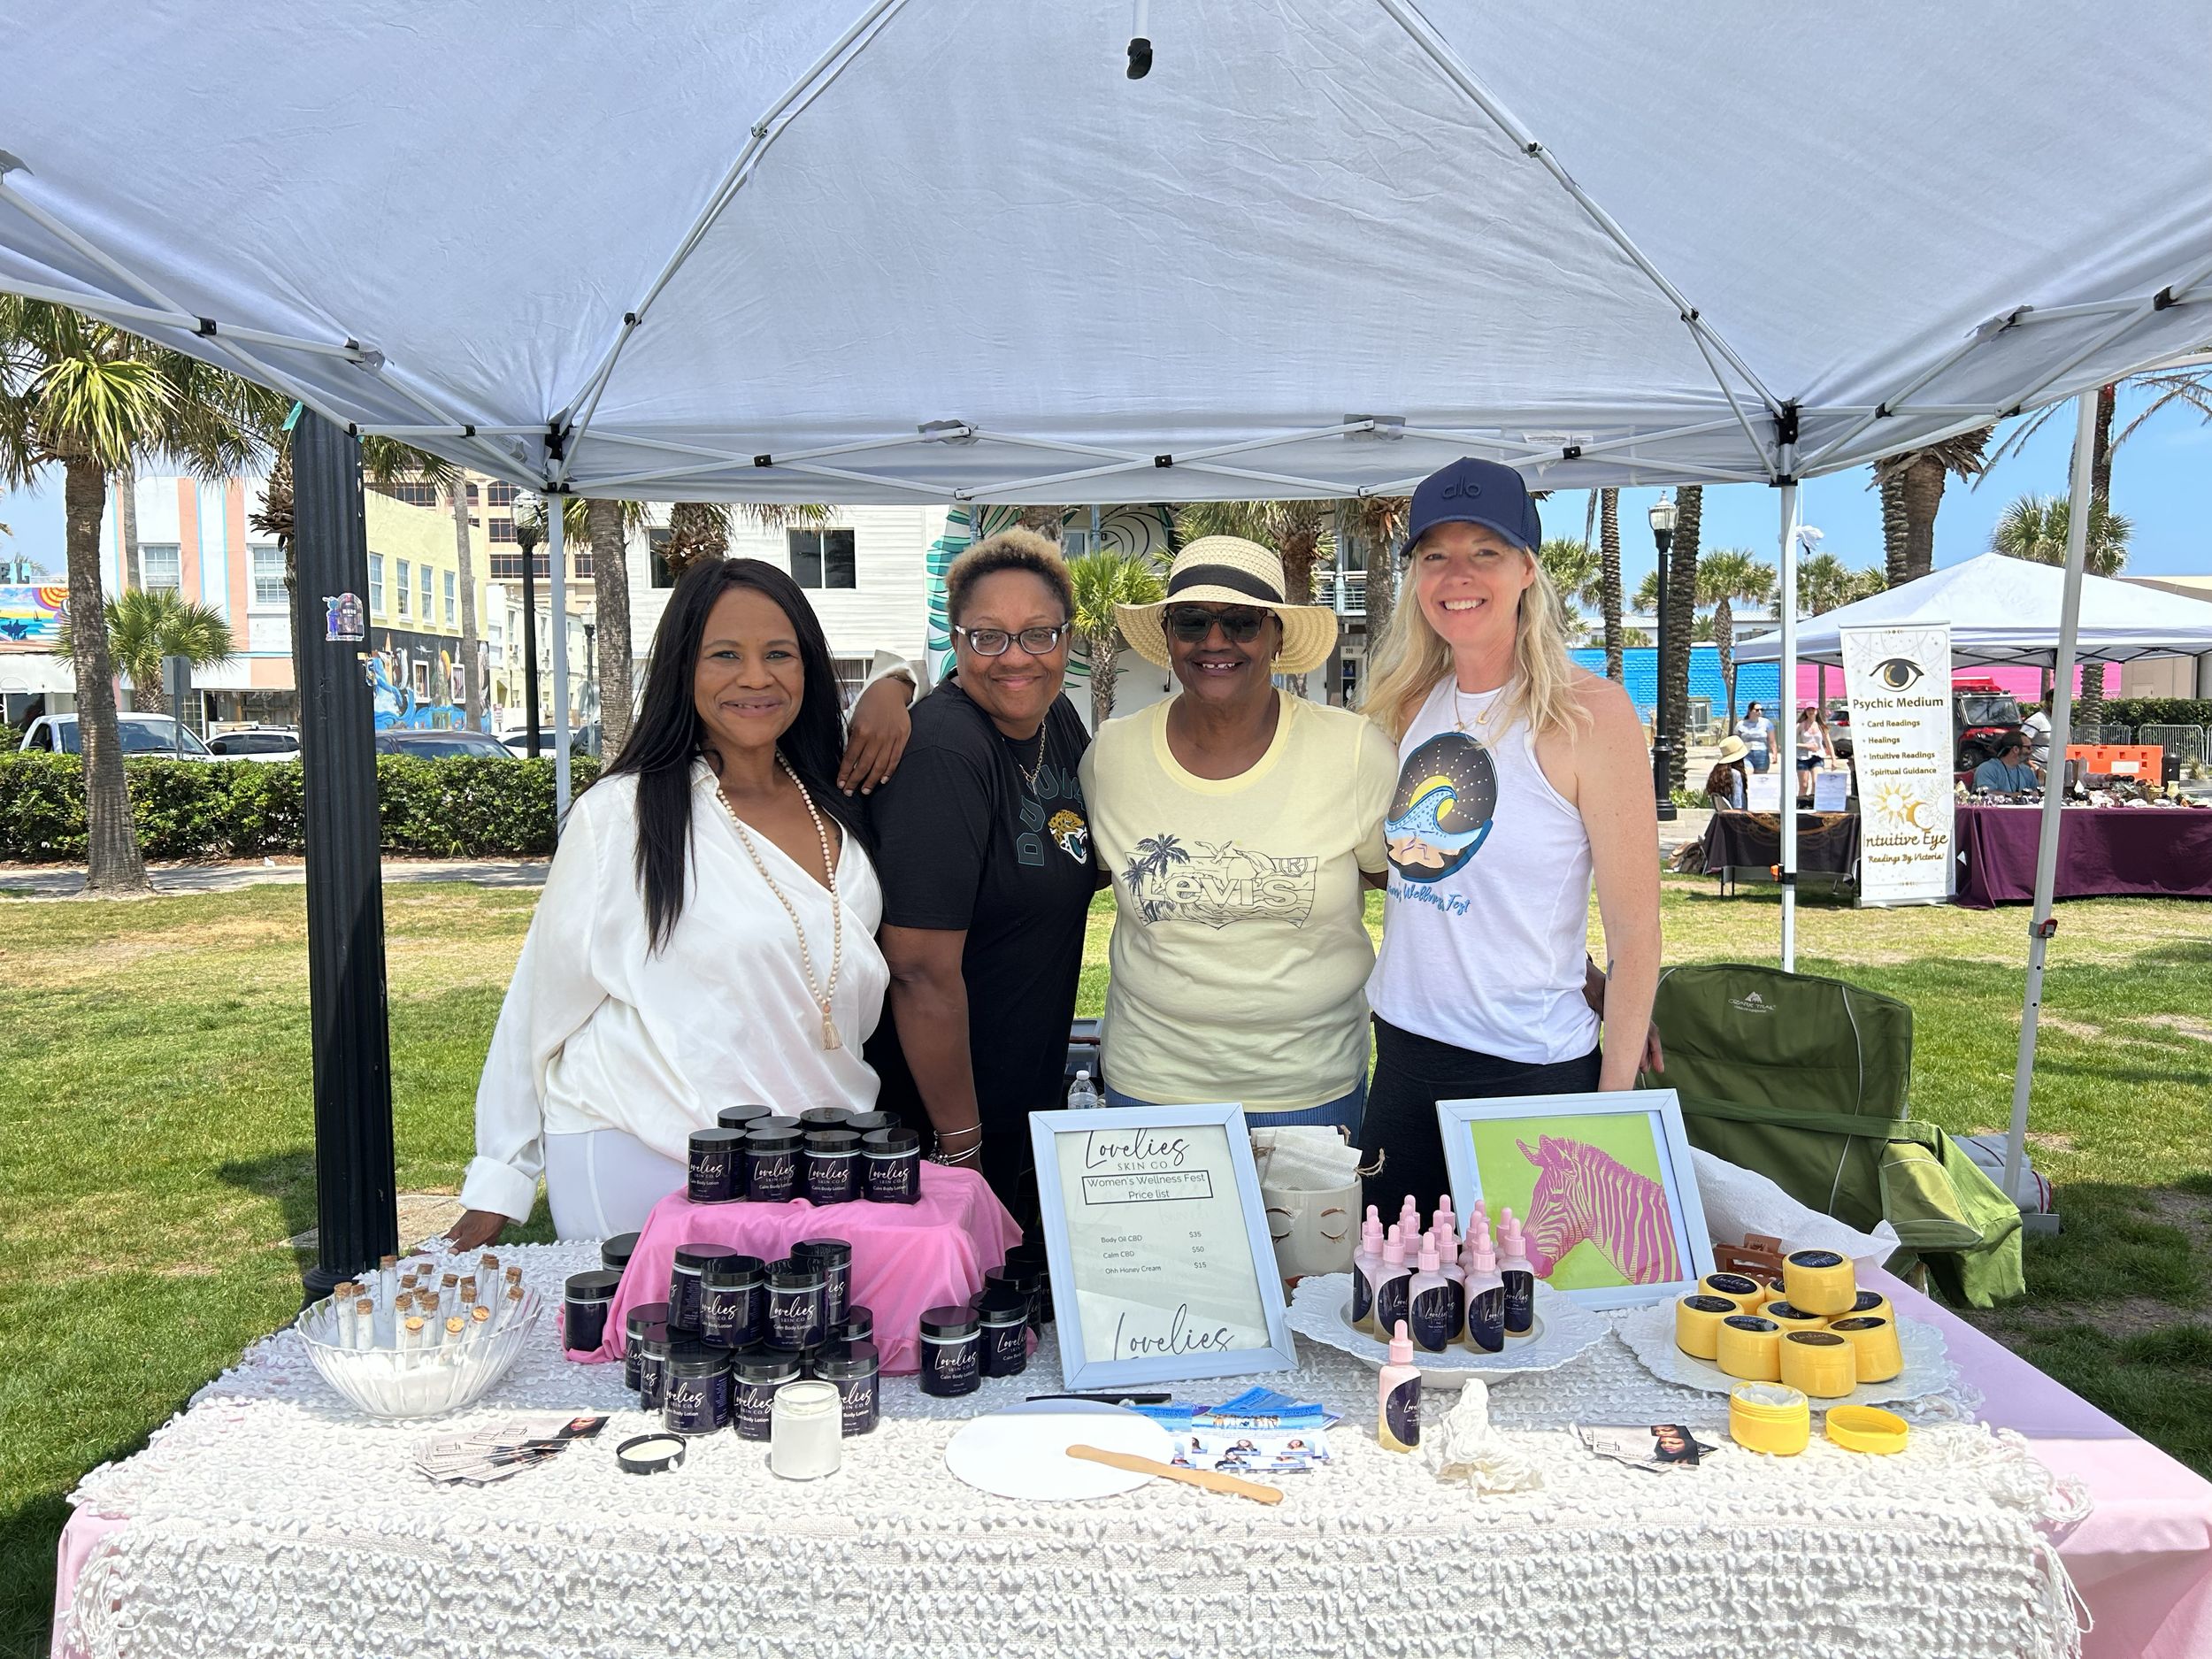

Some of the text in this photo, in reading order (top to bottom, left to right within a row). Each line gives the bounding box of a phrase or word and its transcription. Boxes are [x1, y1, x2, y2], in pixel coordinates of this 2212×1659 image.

[1441, 475, 1482, 499] alo
[1853, 696, 1944, 711] Psychic Medium
[1886, 719, 1920, 728] Readings
[1868, 736, 1901, 745] Healings
[1869, 751, 1900, 760] Intuitive
[1870, 768, 1901, 777] Spiritual
[1923, 831, 1948, 850] Eye
[1868, 854, 1901, 865] Readings
[1901, 854, 1913, 864] By
[1728, 998, 1754, 1008] OZARK
[1086, 1127, 1190, 1169] Lovelies
[754, 1157, 795, 1181] Lovelies
[808, 1160, 850, 1182] Lovelies
[869, 1160, 910, 1182] Lovelies
[1118, 1161, 1145, 1171] SKIN
[1087, 1173, 1205, 1187] Women's Wellness Fest
[1128, 1189, 1170, 1200] Price list
[770, 1295, 816, 1320] Lovelies
[1114, 1303, 1234, 1361] Lovelies
[934, 1345, 978, 1371] Lovelies
